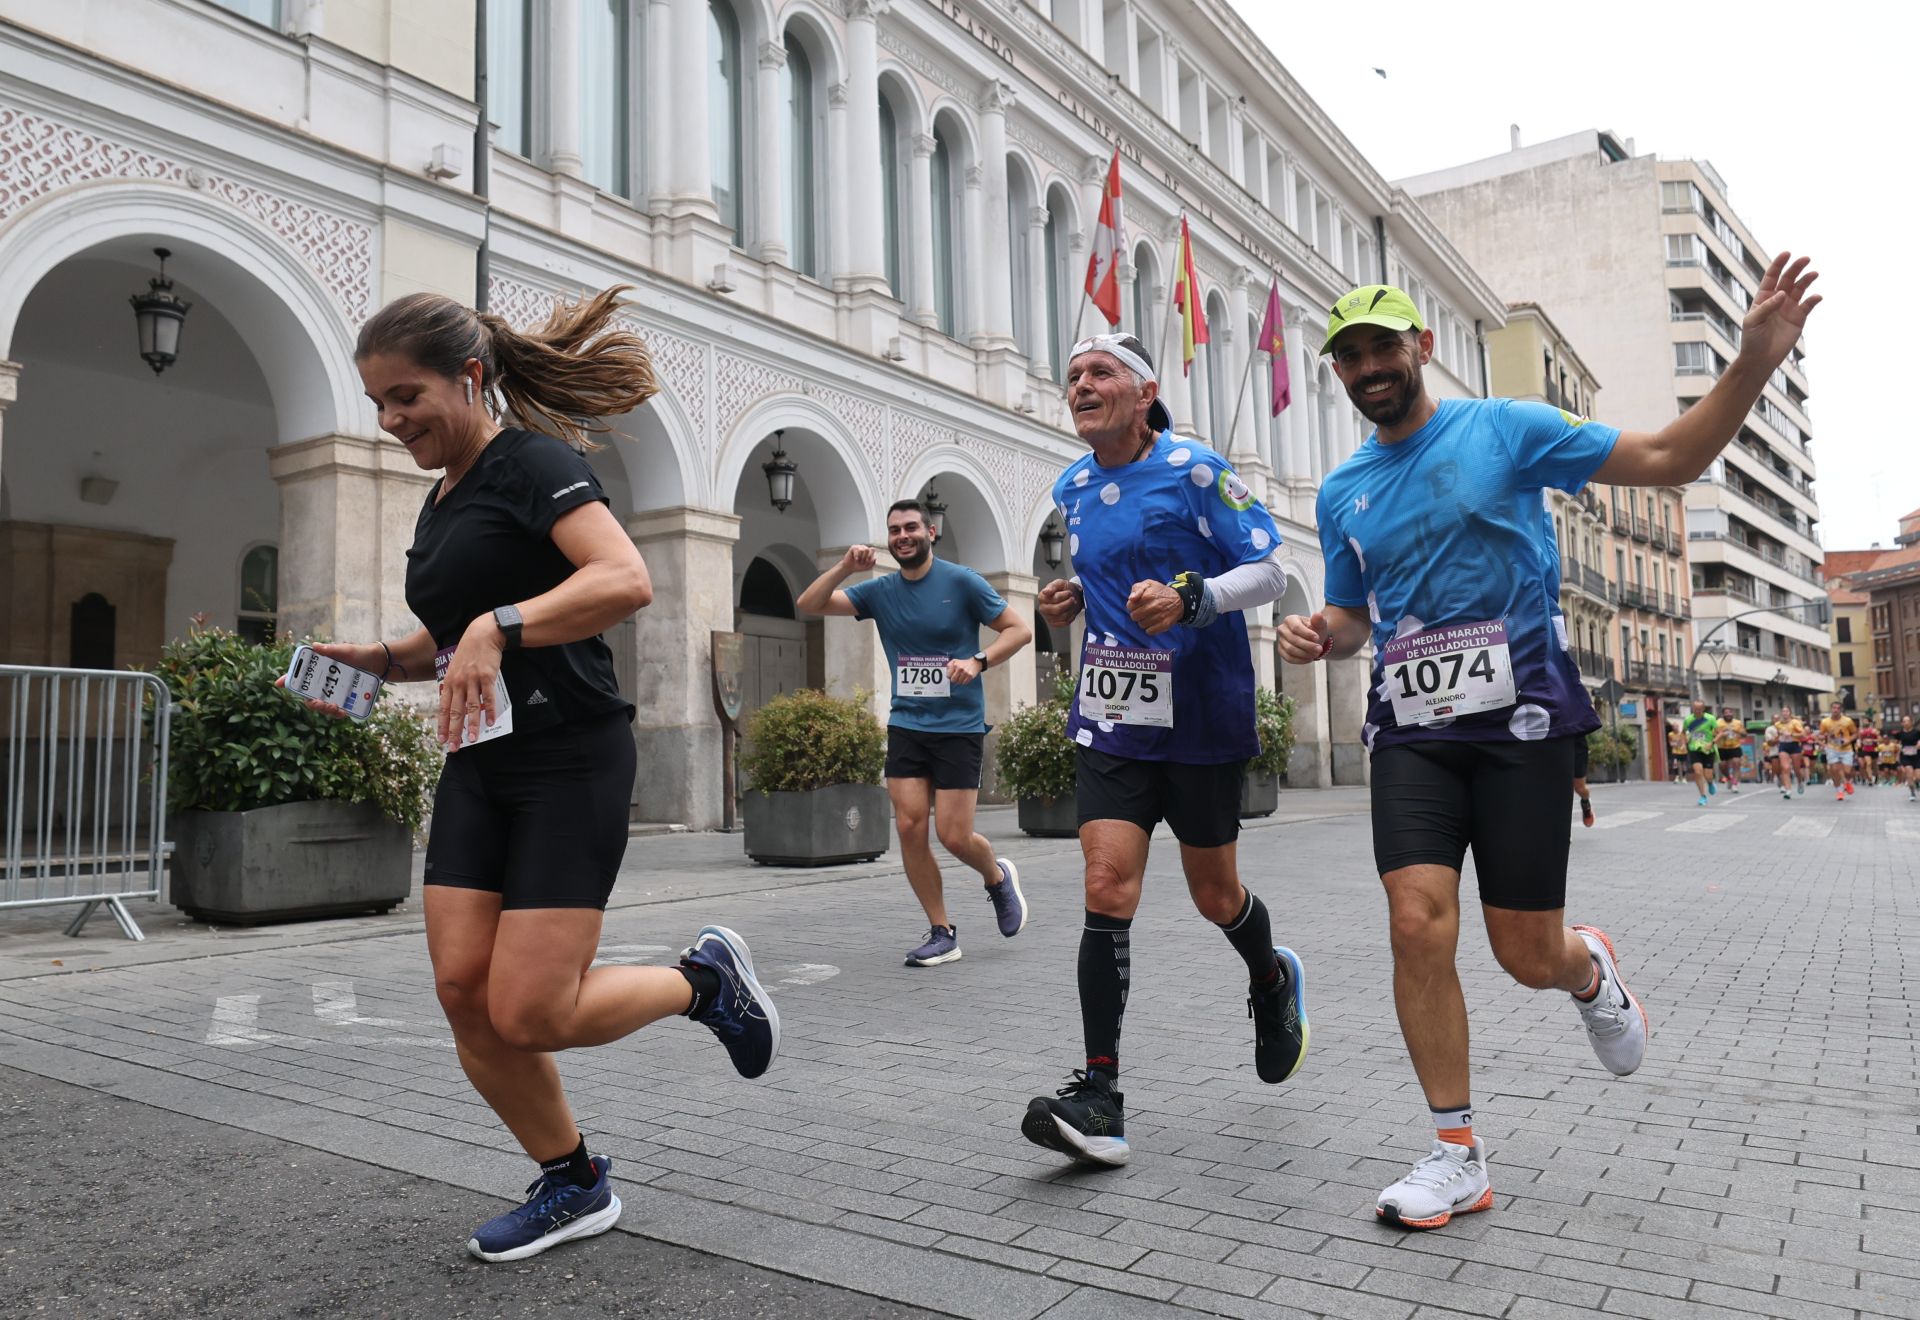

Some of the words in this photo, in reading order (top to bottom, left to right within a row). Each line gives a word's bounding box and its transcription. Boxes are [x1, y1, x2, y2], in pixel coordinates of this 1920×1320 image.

[1412, 633, 1445, 648] MEDIA
[1447, 623, 1503, 640] MARATÓN
[1100, 649, 1125, 659] MEDIA
[1126, 651, 1171, 662] MARATÓN
[1406, 650, 1420, 660] DE
[1421, 637, 1489, 655] VALLADOLID
[301, 654, 320, 691] 01:39:35
[1095, 657, 1104, 666] DE
[1105, 660, 1158, 671] VALLADOLID
[1394, 650, 1496, 699] 1074
[322, 664, 341, 698] 4:19
[901, 667, 943, 685] 1780
[1085, 668, 1159, 703] 1075
[1105, 704, 1130, 712] ISIDORO
[1425, 692, 1466, 707] ALEJANDRO
